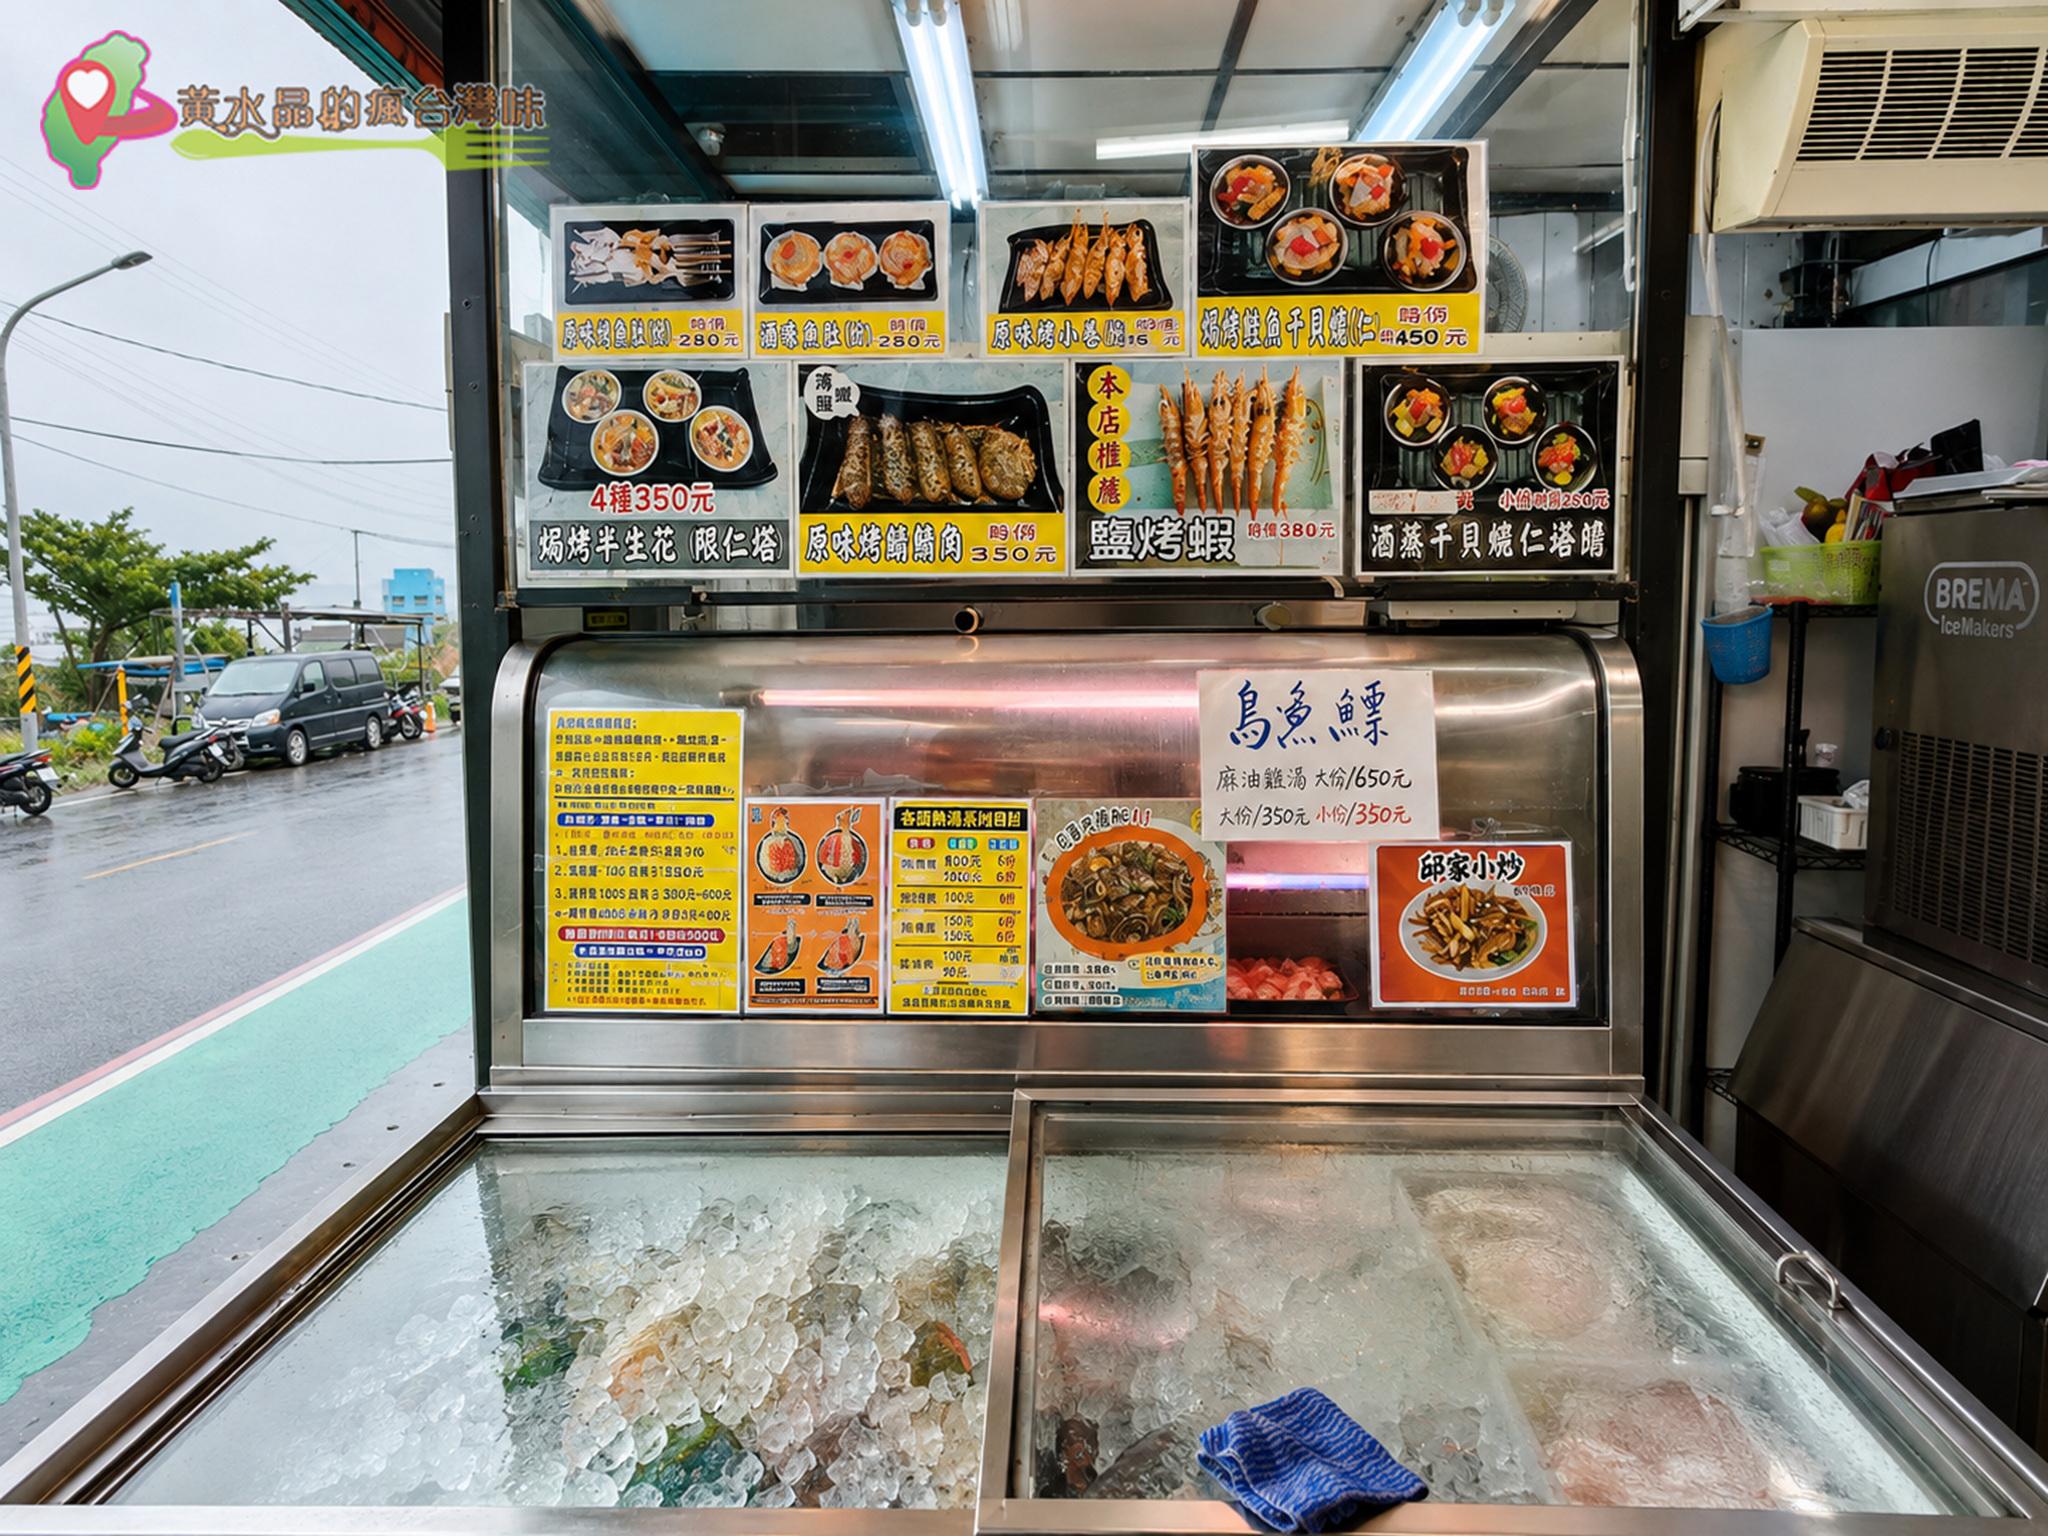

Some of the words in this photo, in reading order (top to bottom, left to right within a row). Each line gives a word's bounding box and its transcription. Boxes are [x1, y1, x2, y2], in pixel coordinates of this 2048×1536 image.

[590, 484, 715, 513] 4種350元
[1935, 577, 2026, 612] BREMA
[1941, 614, 2014, 638] IceMakers
[1420, 853, 1524, 882] 邱家小炒
